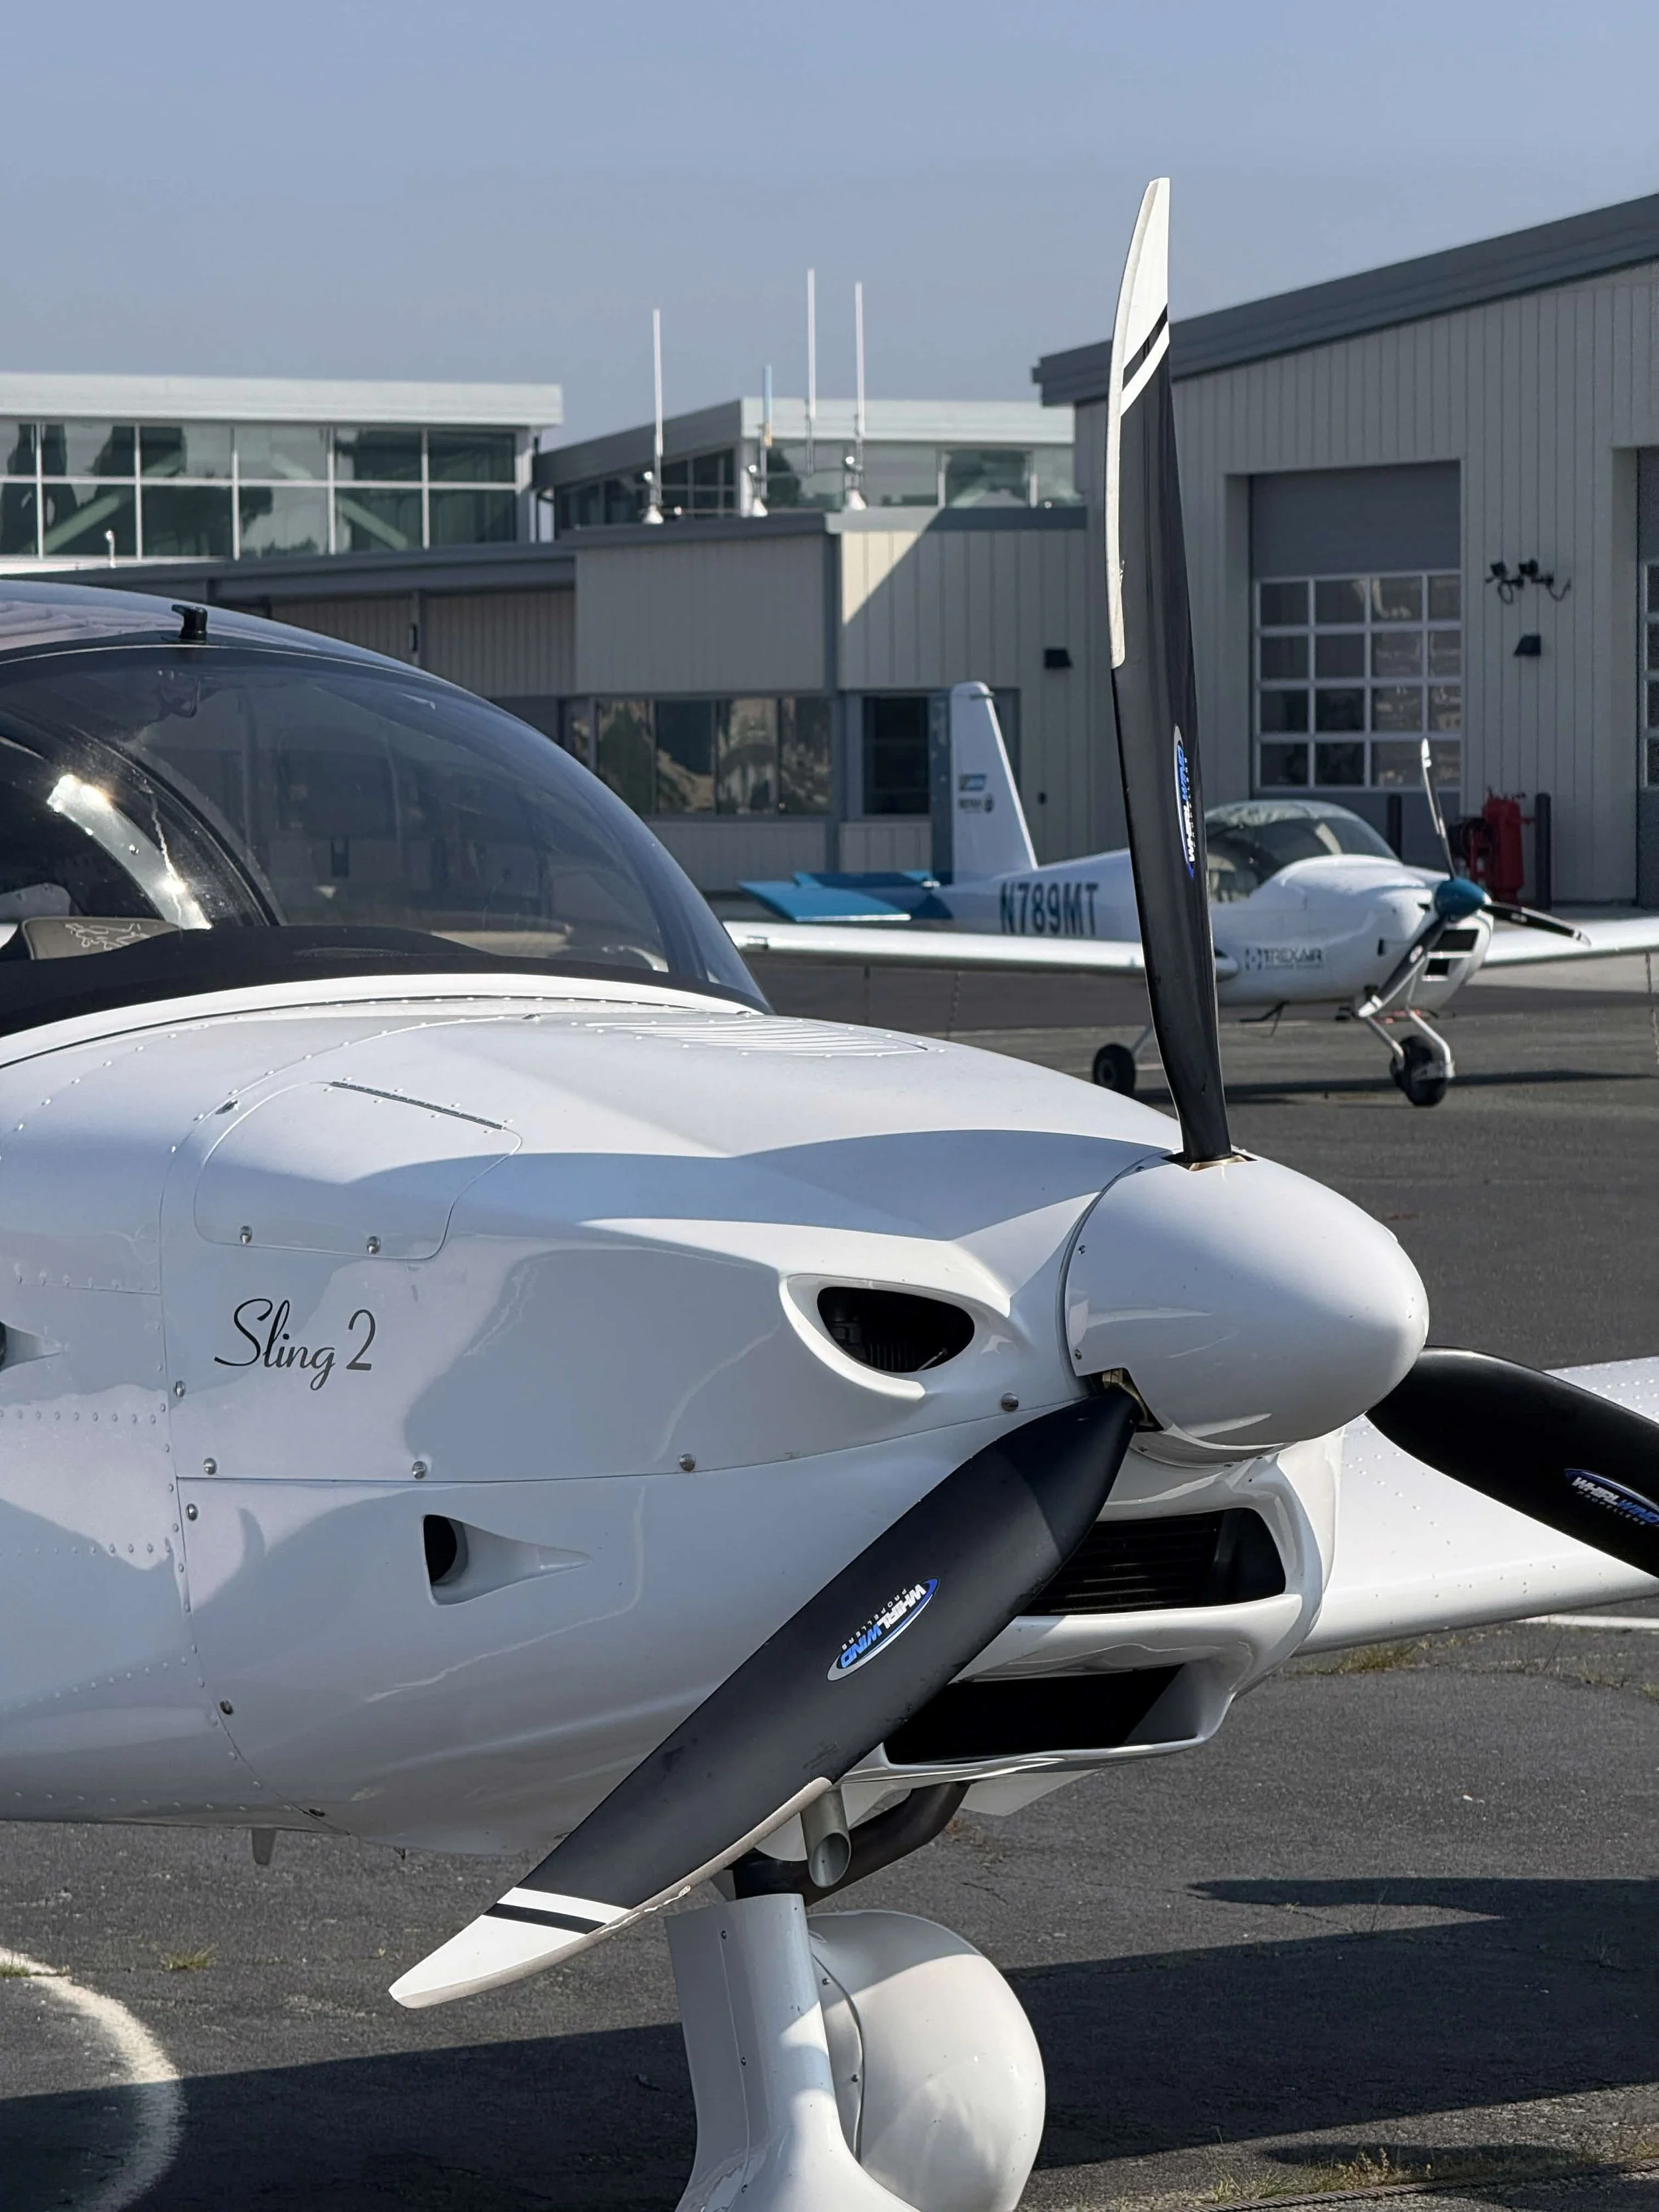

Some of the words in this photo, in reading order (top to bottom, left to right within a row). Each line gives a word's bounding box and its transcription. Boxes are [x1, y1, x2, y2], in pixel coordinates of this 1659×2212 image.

[999, 881, 1098, 936] N789MT
[214, 1298, 335, 1391] Sling
[346, 1309, 376, 1371] 2
[1571, 1477, 1659, 1522] WHIRLWIND
[840, 1584, 926, 1668] WHIRLWIND
[841, 1588, 906, 1651] PROPELLERS
